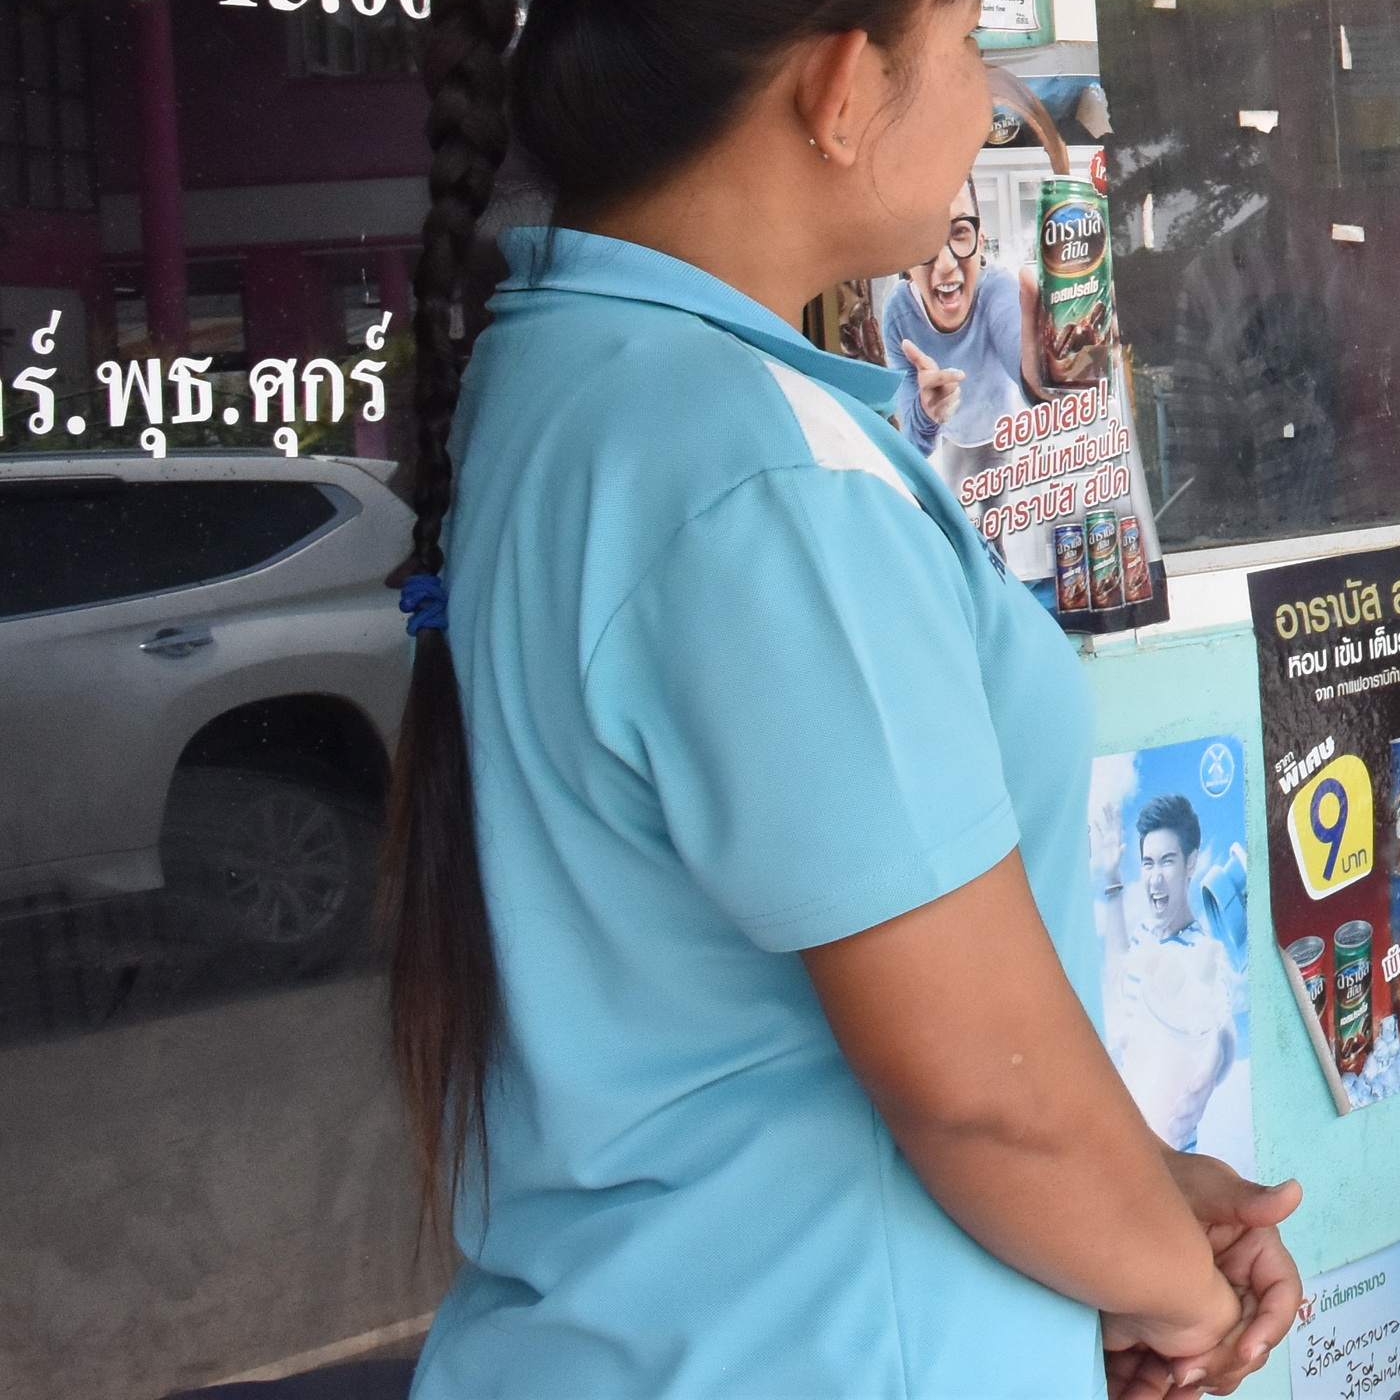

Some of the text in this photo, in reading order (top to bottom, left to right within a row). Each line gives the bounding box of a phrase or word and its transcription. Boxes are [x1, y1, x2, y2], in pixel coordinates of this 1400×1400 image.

[0, 308, 392, 459] ร์.พุธ.ศุกร์
[994, 379, 1109, 451] ลองเลย!
[984, 464, 1129, 539] อาราบัส สปีด
[1275, 578, 1382, 640] อาราบัส
[1287, 650, 1328, 679] หอม
[1334, 636, 1363, 668] เข้ม
[1278, 735, 1336, 795] พิเศษ
[1310, 777, 1349, 881] 9
[1341, 847, 1368, 873] บาท
